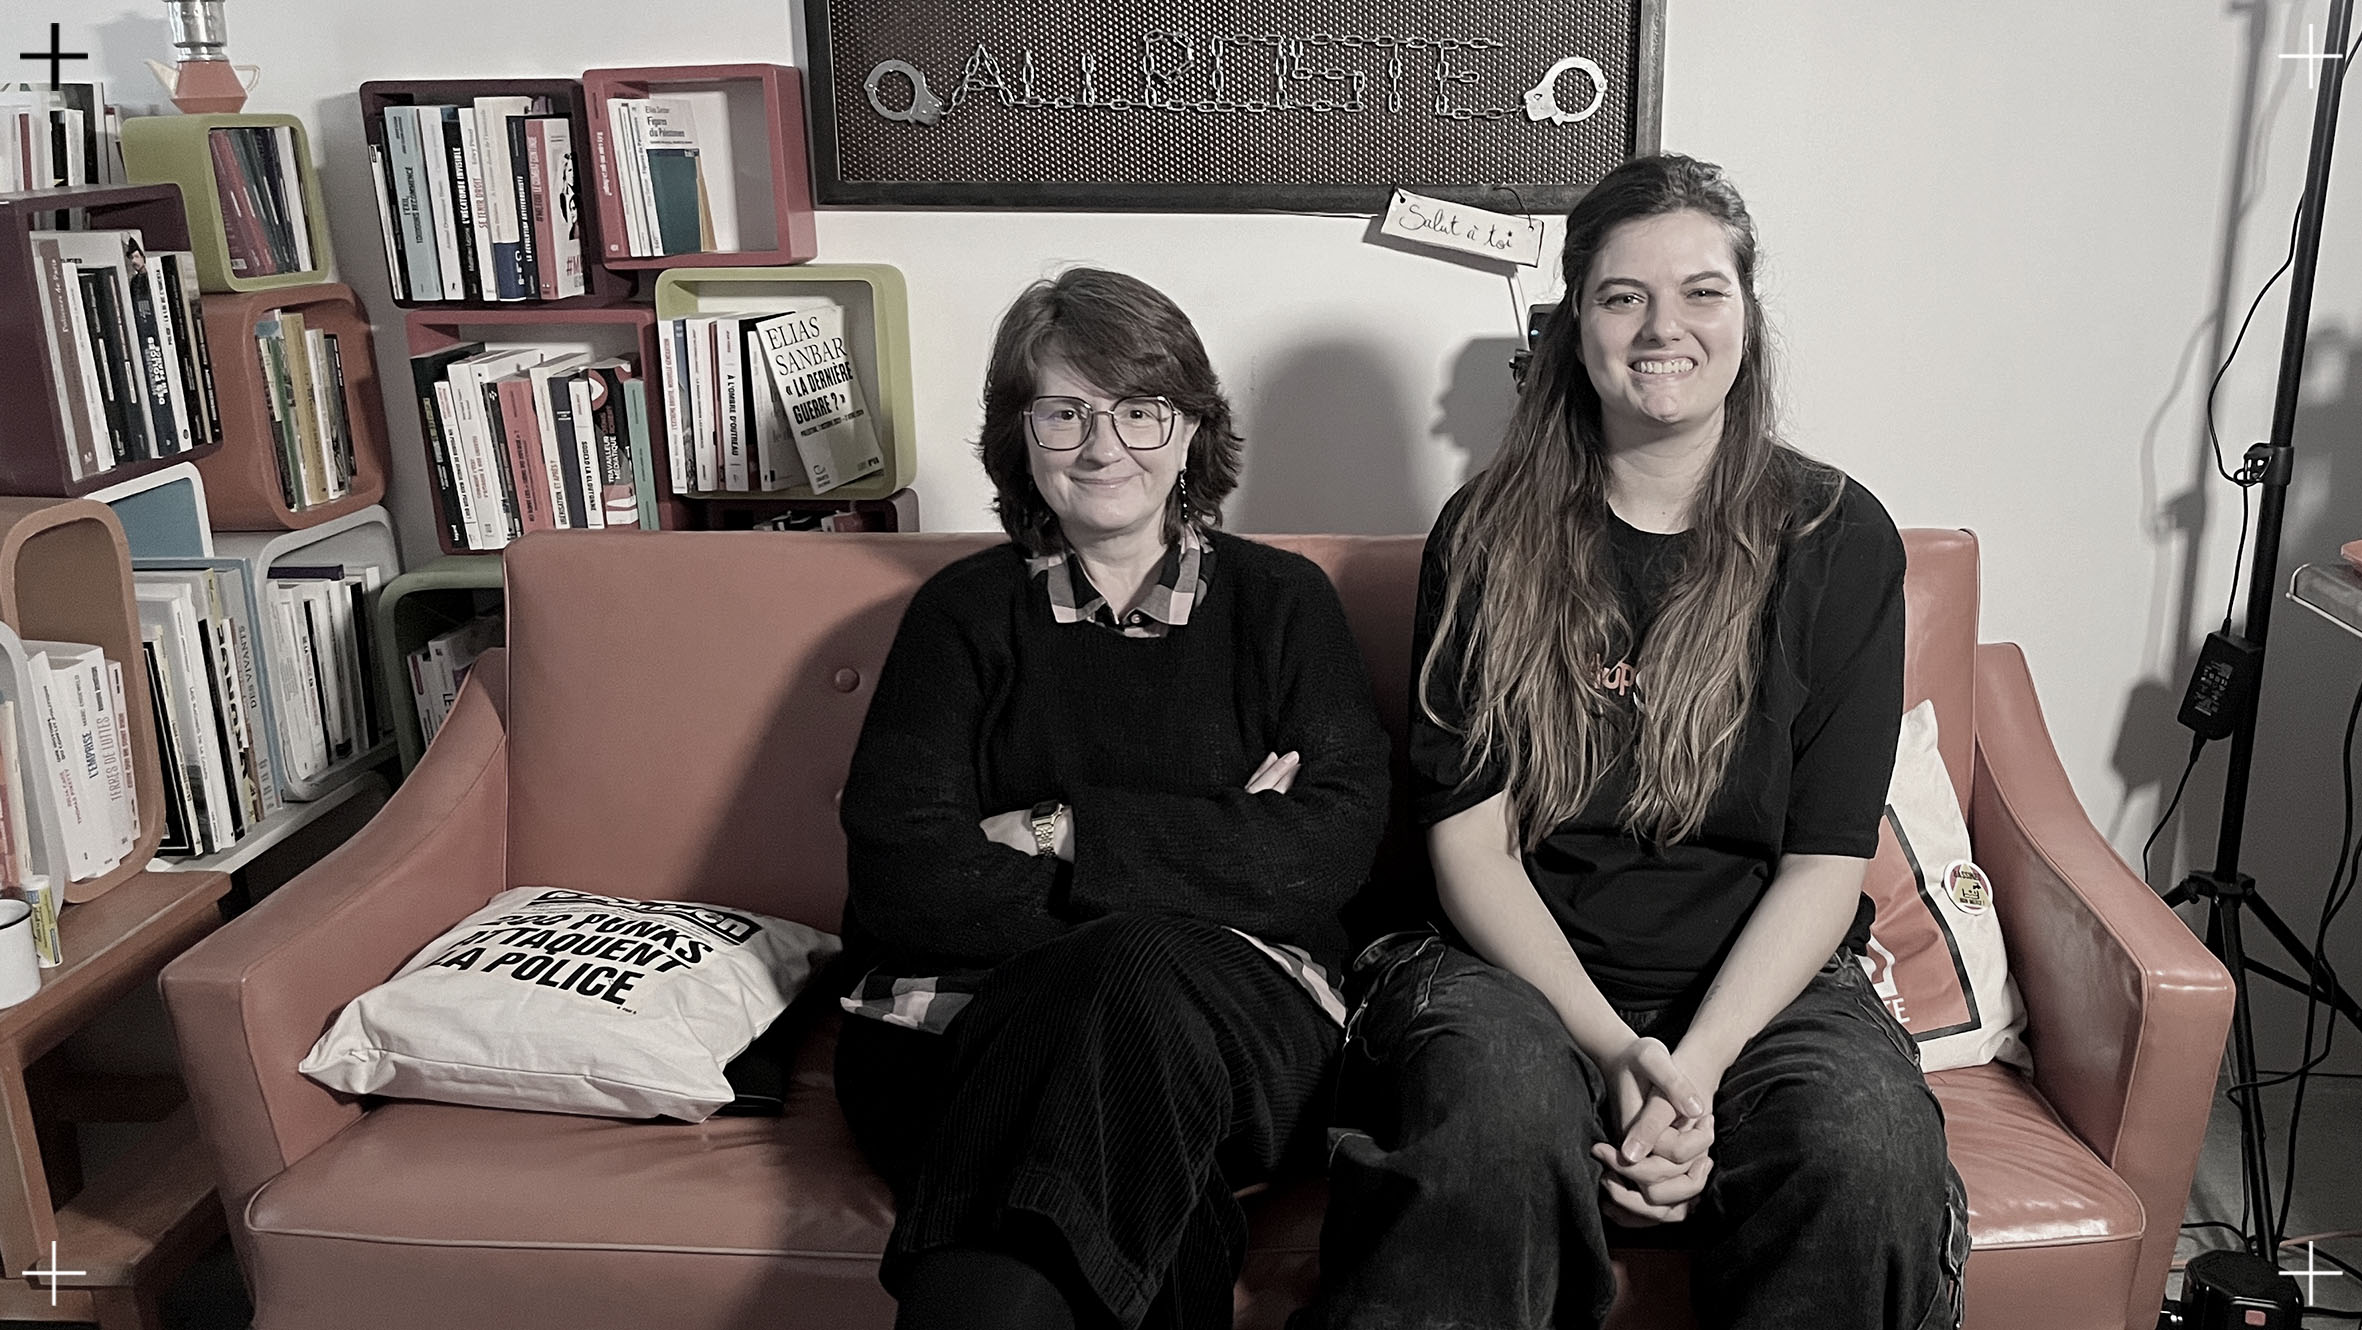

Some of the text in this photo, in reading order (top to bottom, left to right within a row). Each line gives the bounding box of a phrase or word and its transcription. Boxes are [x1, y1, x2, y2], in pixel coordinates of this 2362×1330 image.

[452, 146, 464, 179] INVISIBLE
[475, 198, 486, 219] TENIR
[478, 220, 488, 230] SE
[1399, 204, 1513, 250] Salut à toi
[766, 316, 820, 350] ELIAS
[775, 337, 847, 376] SANBAR
[793, 377, 809, 397] LA
[807, 361, 853, 393] DERNIÈRE
[726, 382, 736, 413] L'OMBRE
[792, 396, 833, 425] GUERRE
[832, 392, 840, 410] ?
[728, 415, 739, 456] D'OUTREAU
[602, 434, 614, 483] TRAVAILLEUR
[236, 624, 254, 682] VIVANTS
[96, 715, 114, 750] LUTTES
[81, 730, 99, 778] L'EMPRISE
[103, 751, 117, 765] DE
[106, 765, 122, 801] TERRES
[447, 927, 693, 973] ATTAQUENT
[568, 913, 714, 965] PUNKS
[422, 947, 645, 1005] LA POLICE
